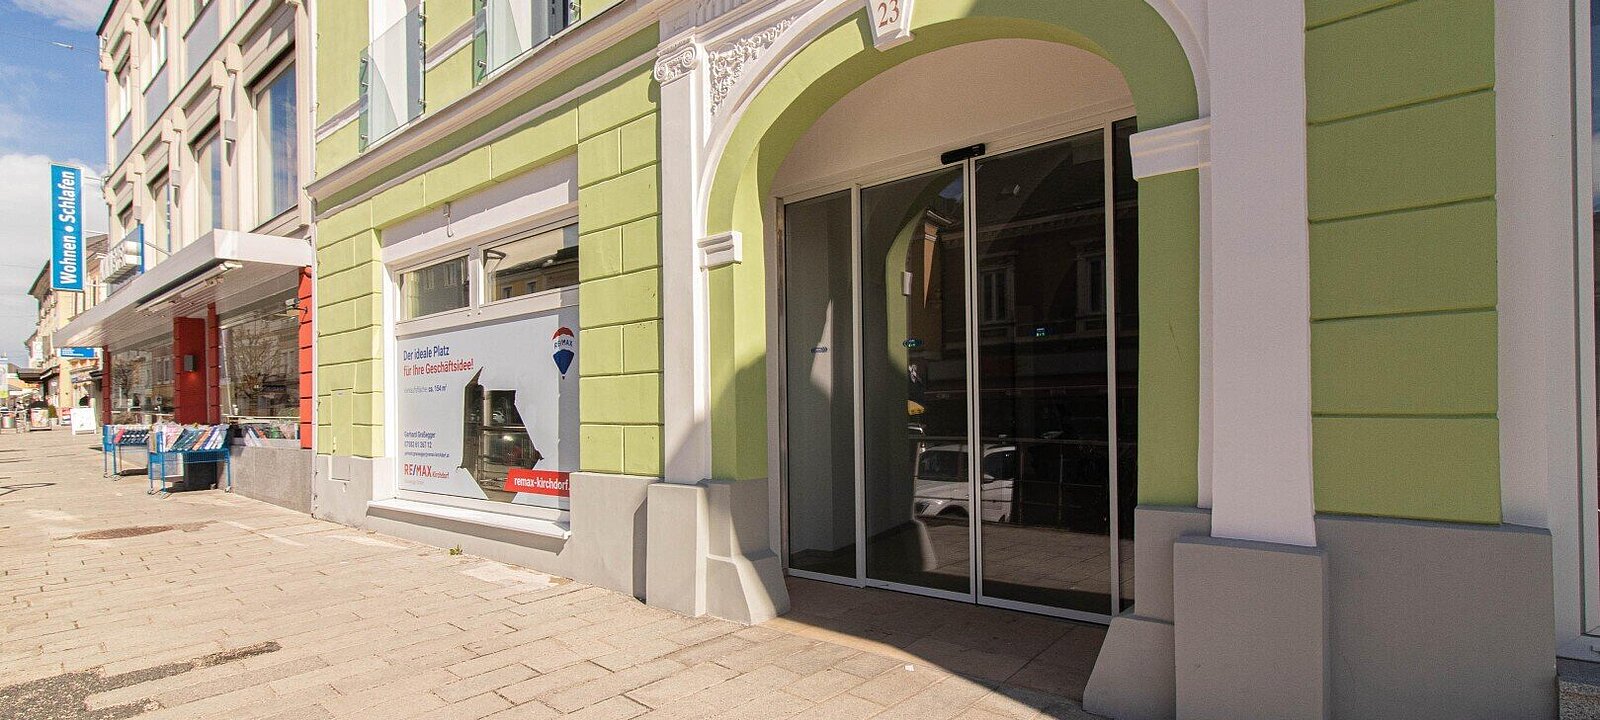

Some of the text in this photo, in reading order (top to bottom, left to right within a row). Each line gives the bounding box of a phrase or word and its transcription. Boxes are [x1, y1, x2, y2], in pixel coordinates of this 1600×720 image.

[877, 0, 900, 27] 23
[58, 171, 77, 284] Wohnen Schlafen
[403, 345, 450, 361] Der ideale Platz
[403, 358, 474, 377] für Ihre Geschäftsidee!
[404, 463, 432, 478] RE/MAX
